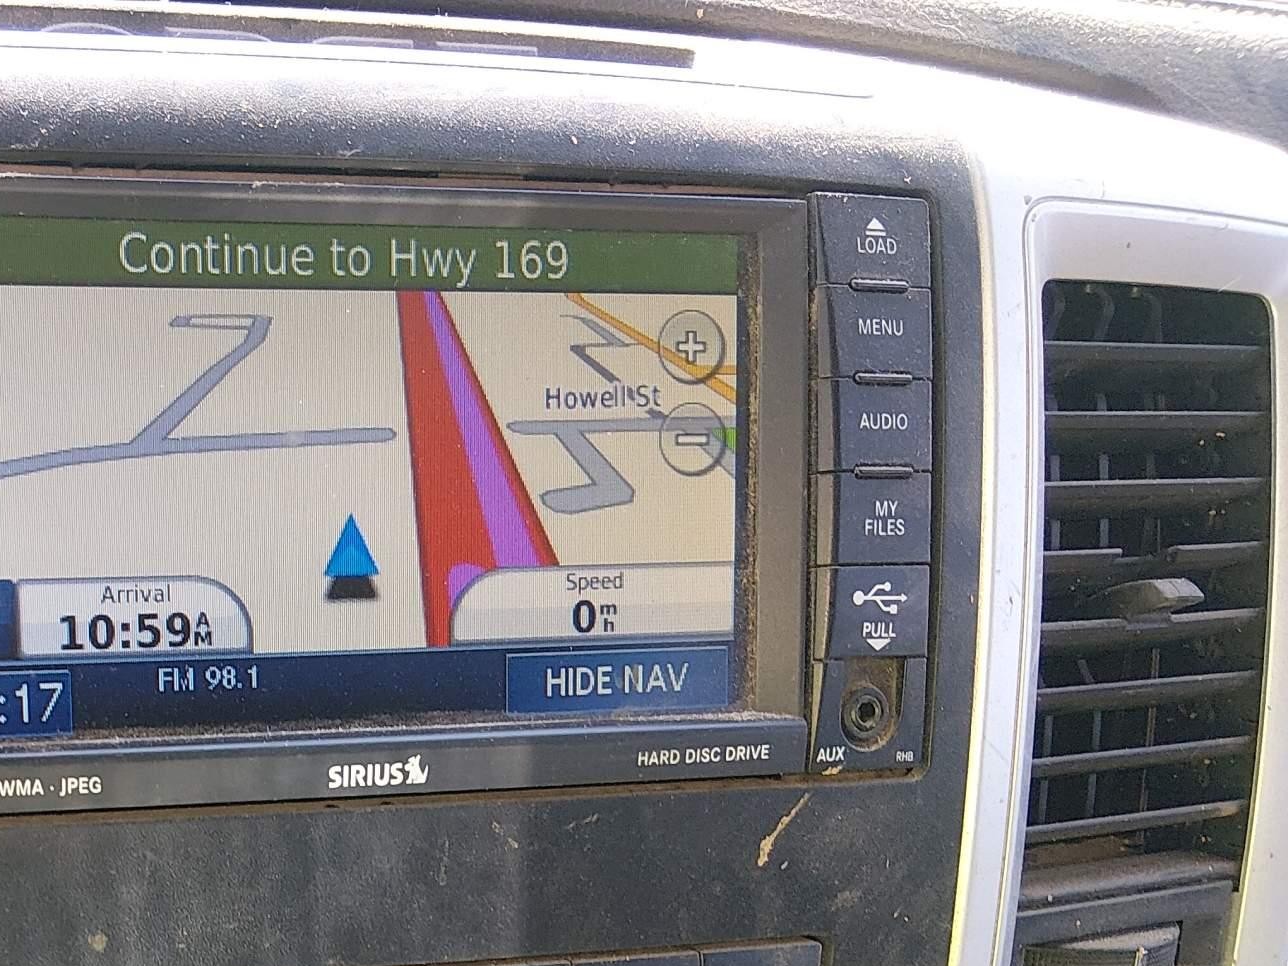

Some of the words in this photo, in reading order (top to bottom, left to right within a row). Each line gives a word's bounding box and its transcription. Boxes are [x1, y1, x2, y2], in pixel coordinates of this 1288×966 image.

[857, 236, 897, 255] LOAD
[119, 232, 315, 276] Continue
[330, 238, 372, 277] to
[390, 239, 476, 287] Hwy
[494, 240, 569, 280] 169
[858, 318, 904, 336] MENU
[545, 385, 626, 409] Howell
[636, 385, 661, 407] St
[859, 413, 908, 430] AUDIO
[875, 501, 898, 517] MY
[865, 518, 905, 536] FILES
[566, 571, 624, 595] Speed
[101, 584, 171, 604] Arrival
[862, 621, 897, 638] PULL
[158, 666, 195, 693] FM
[204, 664, 260, 690] 98.1
[545, 665, 612, 698] HIDE
[623, 663, 689, 694] NAV
[636, 750, 680, 769] HARD
[685, 749, 719, 766] DISC
[723, 745, 771, 764] DRIVE
[816, 746, 846, 762] AUX
[328, 762, 404, 789] SIRIUS
[58, 776, 102, 796] JPEG
